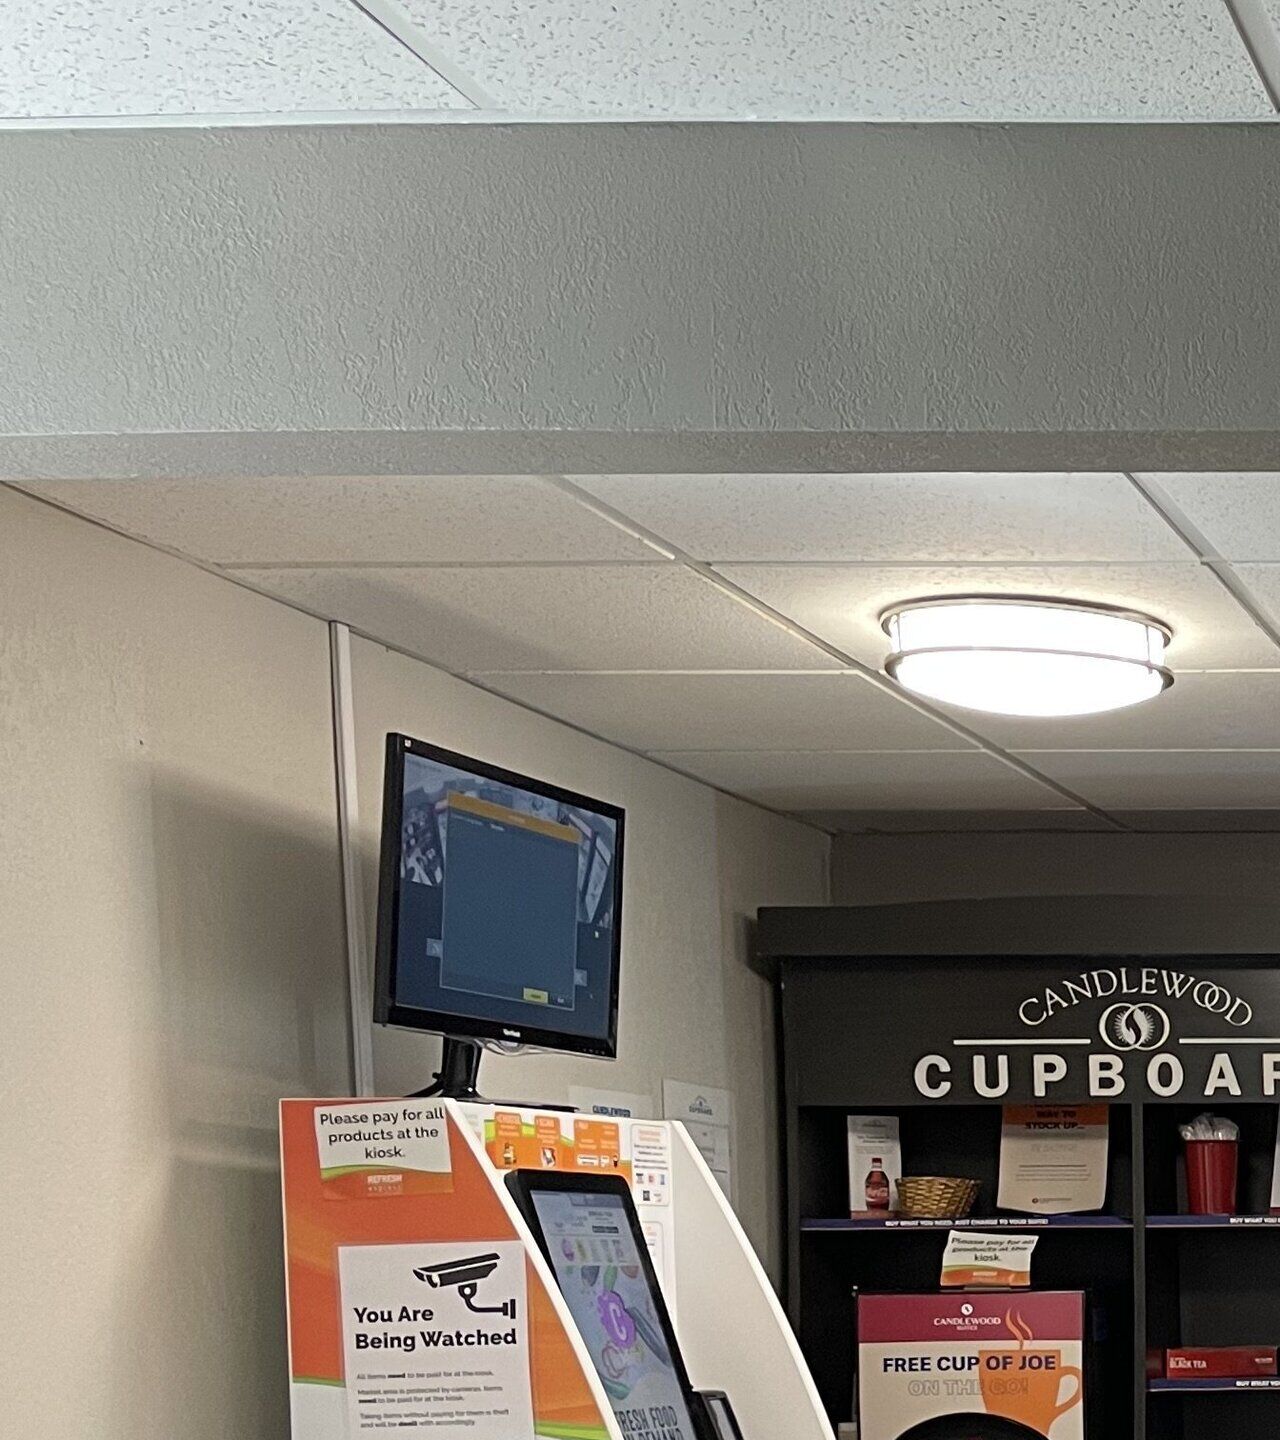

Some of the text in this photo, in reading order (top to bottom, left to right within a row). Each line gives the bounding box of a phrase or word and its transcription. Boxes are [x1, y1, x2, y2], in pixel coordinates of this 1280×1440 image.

[1018, 967, 1252, 1026] CANDLEWOOD
[320, 1107, 444, 1125] Please pay for all
[329, 1126, 438, 1145] products at the
[365, 1146, 405, 1158] kiosk.
[974, 1254, 1001, 1262] kiosk.
[354, 1306, 434, 1324] You Are
[934, 1318, 1000, 1326] CANDLEWOOD
[355, 1328, 517, 1351] Being Watched
[883, 1356, 1056, 1372] FREE CUP OF JOE
[1194, 1360, 1206, 1368] TEA
[908, 1378, 1028, 1396] ON THE GO!
[650, 1406, 678, 1428] FOOD
